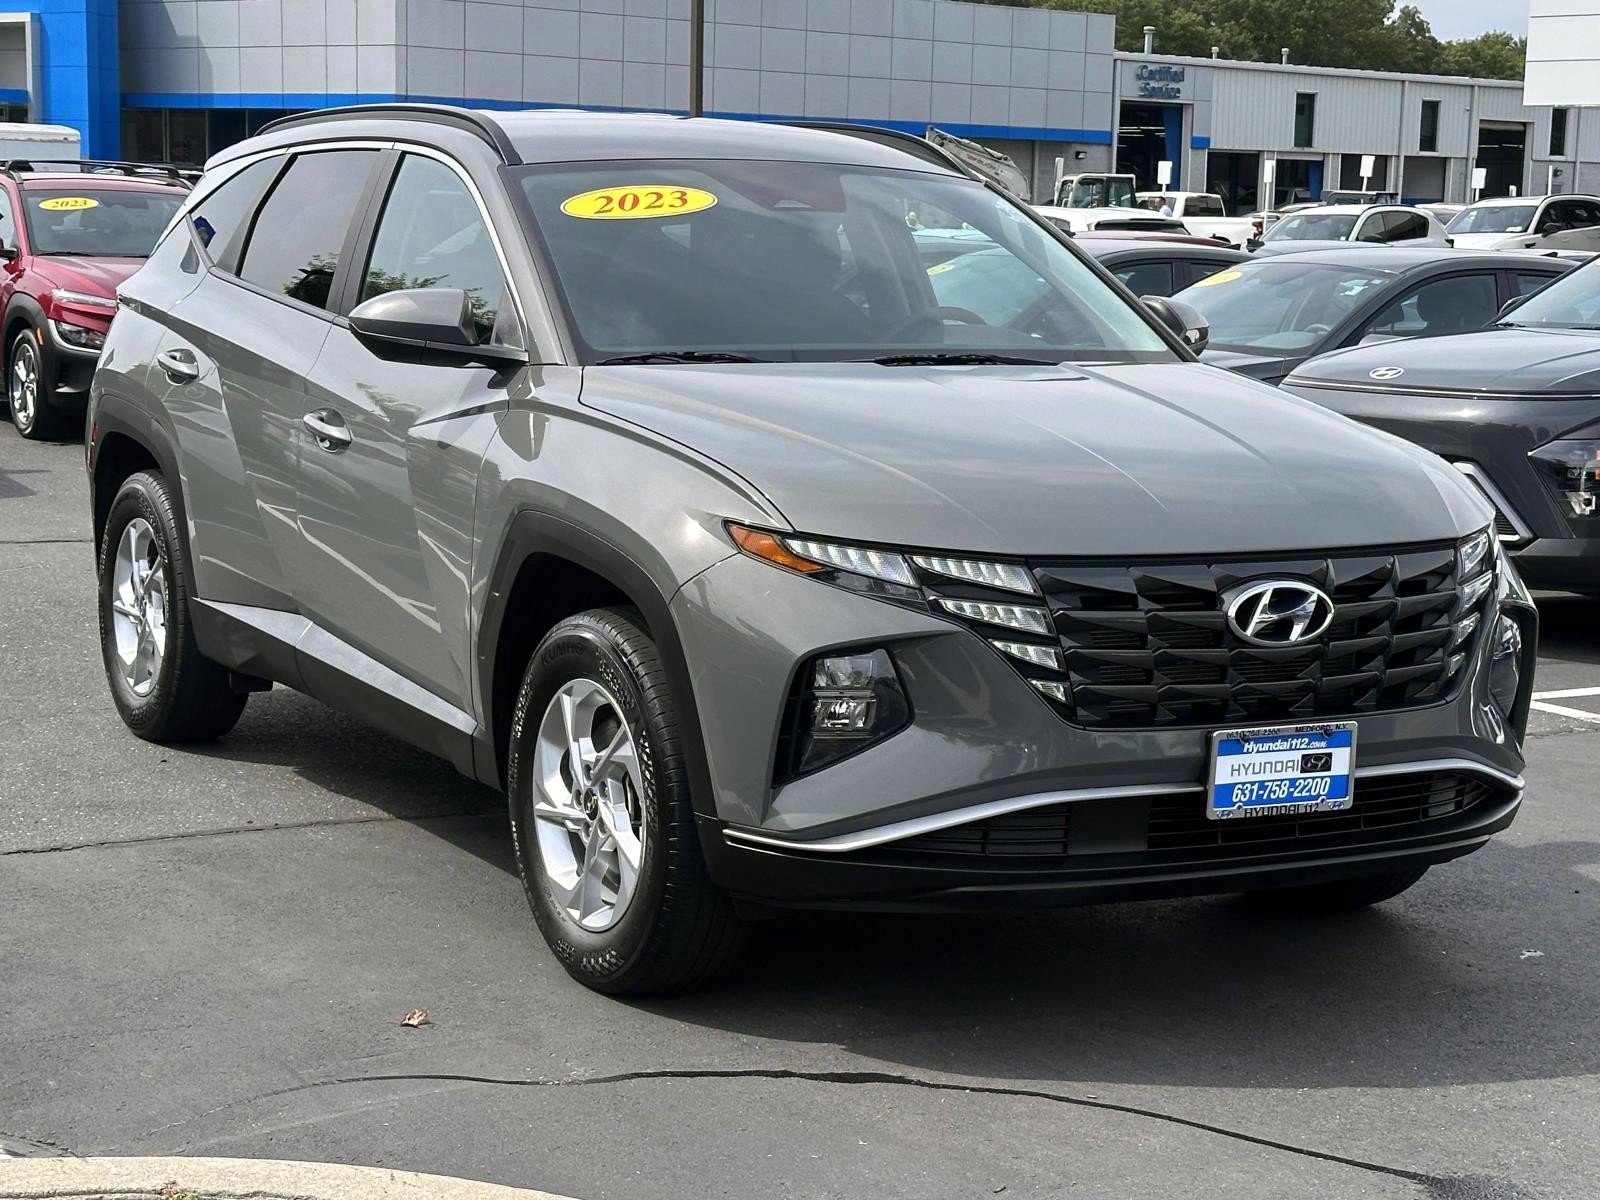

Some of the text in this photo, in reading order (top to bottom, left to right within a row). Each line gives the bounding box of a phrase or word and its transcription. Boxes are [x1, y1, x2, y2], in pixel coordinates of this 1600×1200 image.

[1136, 65, 1184, 82] Certified
[1139, 82, 1180, 98] Service
[52, 200, 88, 208] 2023
[594, 191, 688, 214] 2023
[1243, 738, 1328, 754] Hyundai112.com
[1231, 760, 1299, 777] HYUNDAI
[1232, 778, 1330, 802] 631-758-2200
[1244, 803, 1319, 818] HYUNDAI 112
